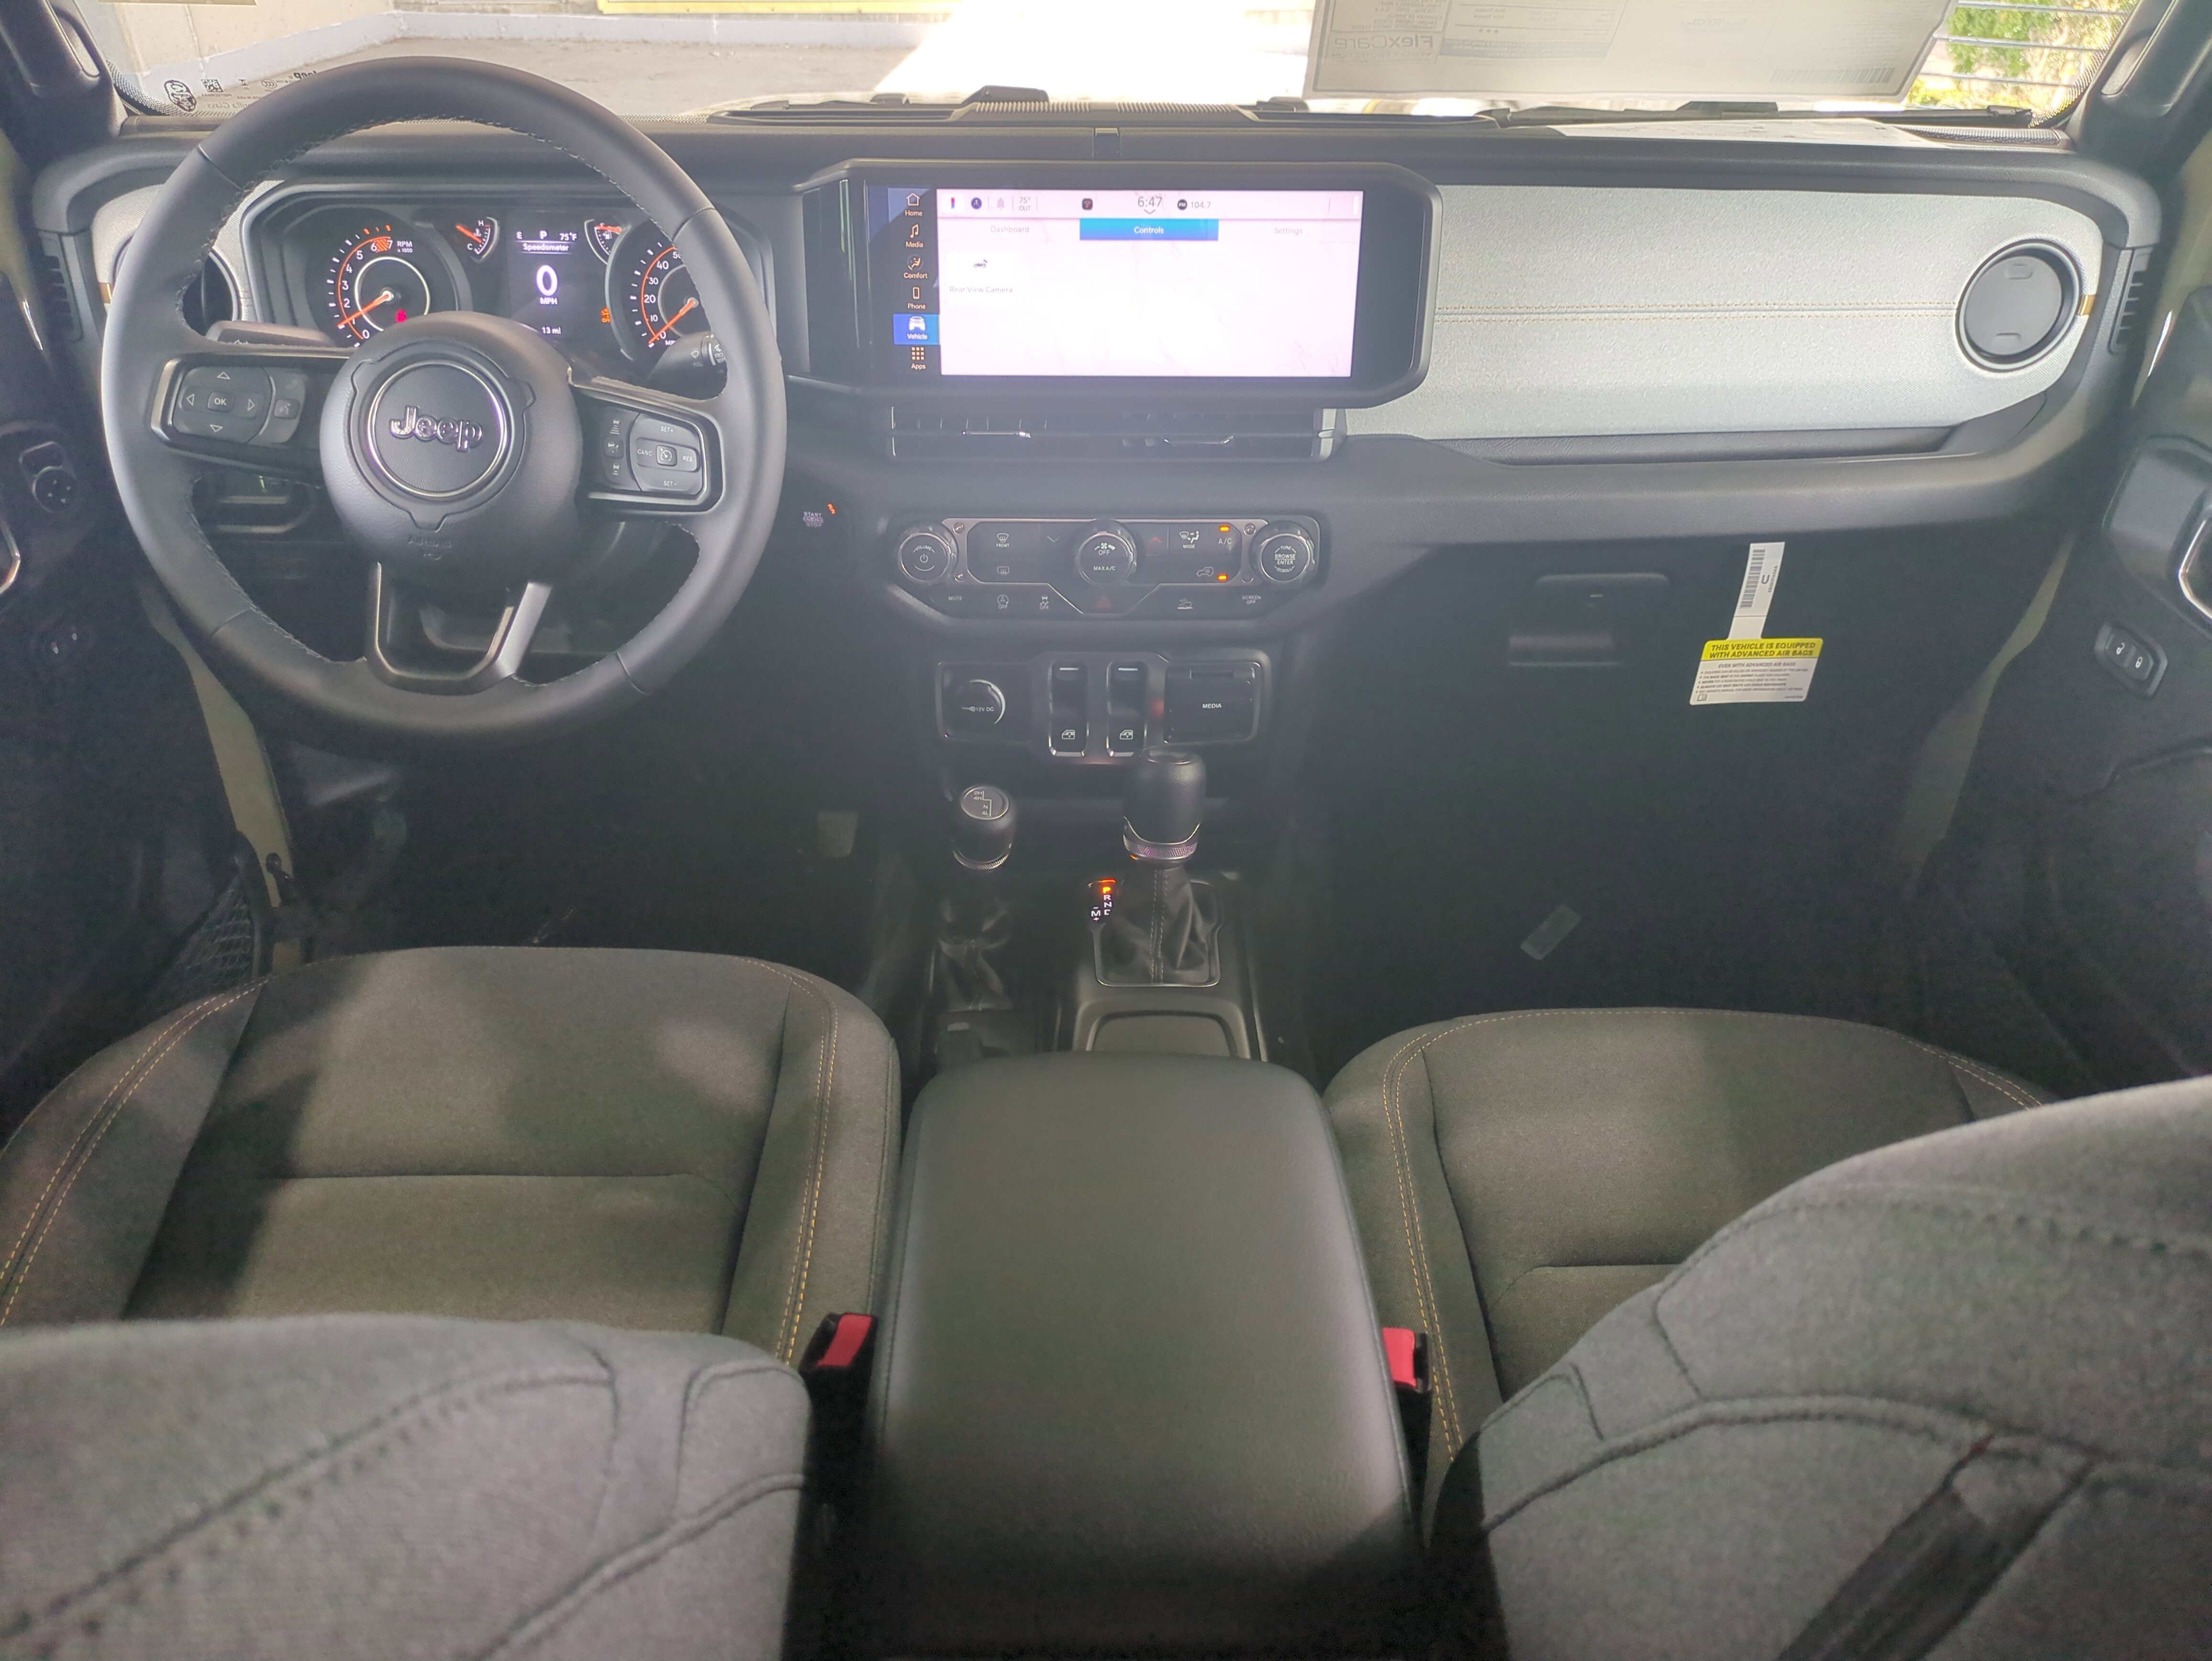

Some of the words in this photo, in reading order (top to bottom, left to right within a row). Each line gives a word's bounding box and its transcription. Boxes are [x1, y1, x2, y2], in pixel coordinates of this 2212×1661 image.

[1138, 196, 1162, 208] 6:47
[1191, 201, 1211, 209] 104.7
[990, 225, 1029, 233] Dashboard
[1133, 226, 1164, 234] Controls
[1274, 227, 1303, 236] Settings
[517, 231, 523, 240] E
[540, 230, 548, 240] P
[371, 243, 377, 252] 6
[387, 240, 393, 249] 7
[522, 243, 569, 252] Speedometer
[356, 250, 364, 260] 5
[346, 264, 353, 273] 4
[656, 260, 669, 270] 40
[342, 280, 349, 290] 3
[536, 264, 558, 297] 0
[985, 286, 1013, 294] Camera
[343, 298, 351, 308] 2
[540, 297, 558, 305] MPH
[644, 294, 656, 304] 20
[362, 329, 370, 339] 0
[542, 326, 550, 334] 13
[552, 326, 562, 334] mi
[660, 331, 667, 339] 0
[214, 398, 226, 406] OK
[389, 406, 484, 452] Jeep
[637, 449, 653, 457] CANC
[1217, 537, 1232, 545] A/C
[1709, 651, 1730, 659] WITH
